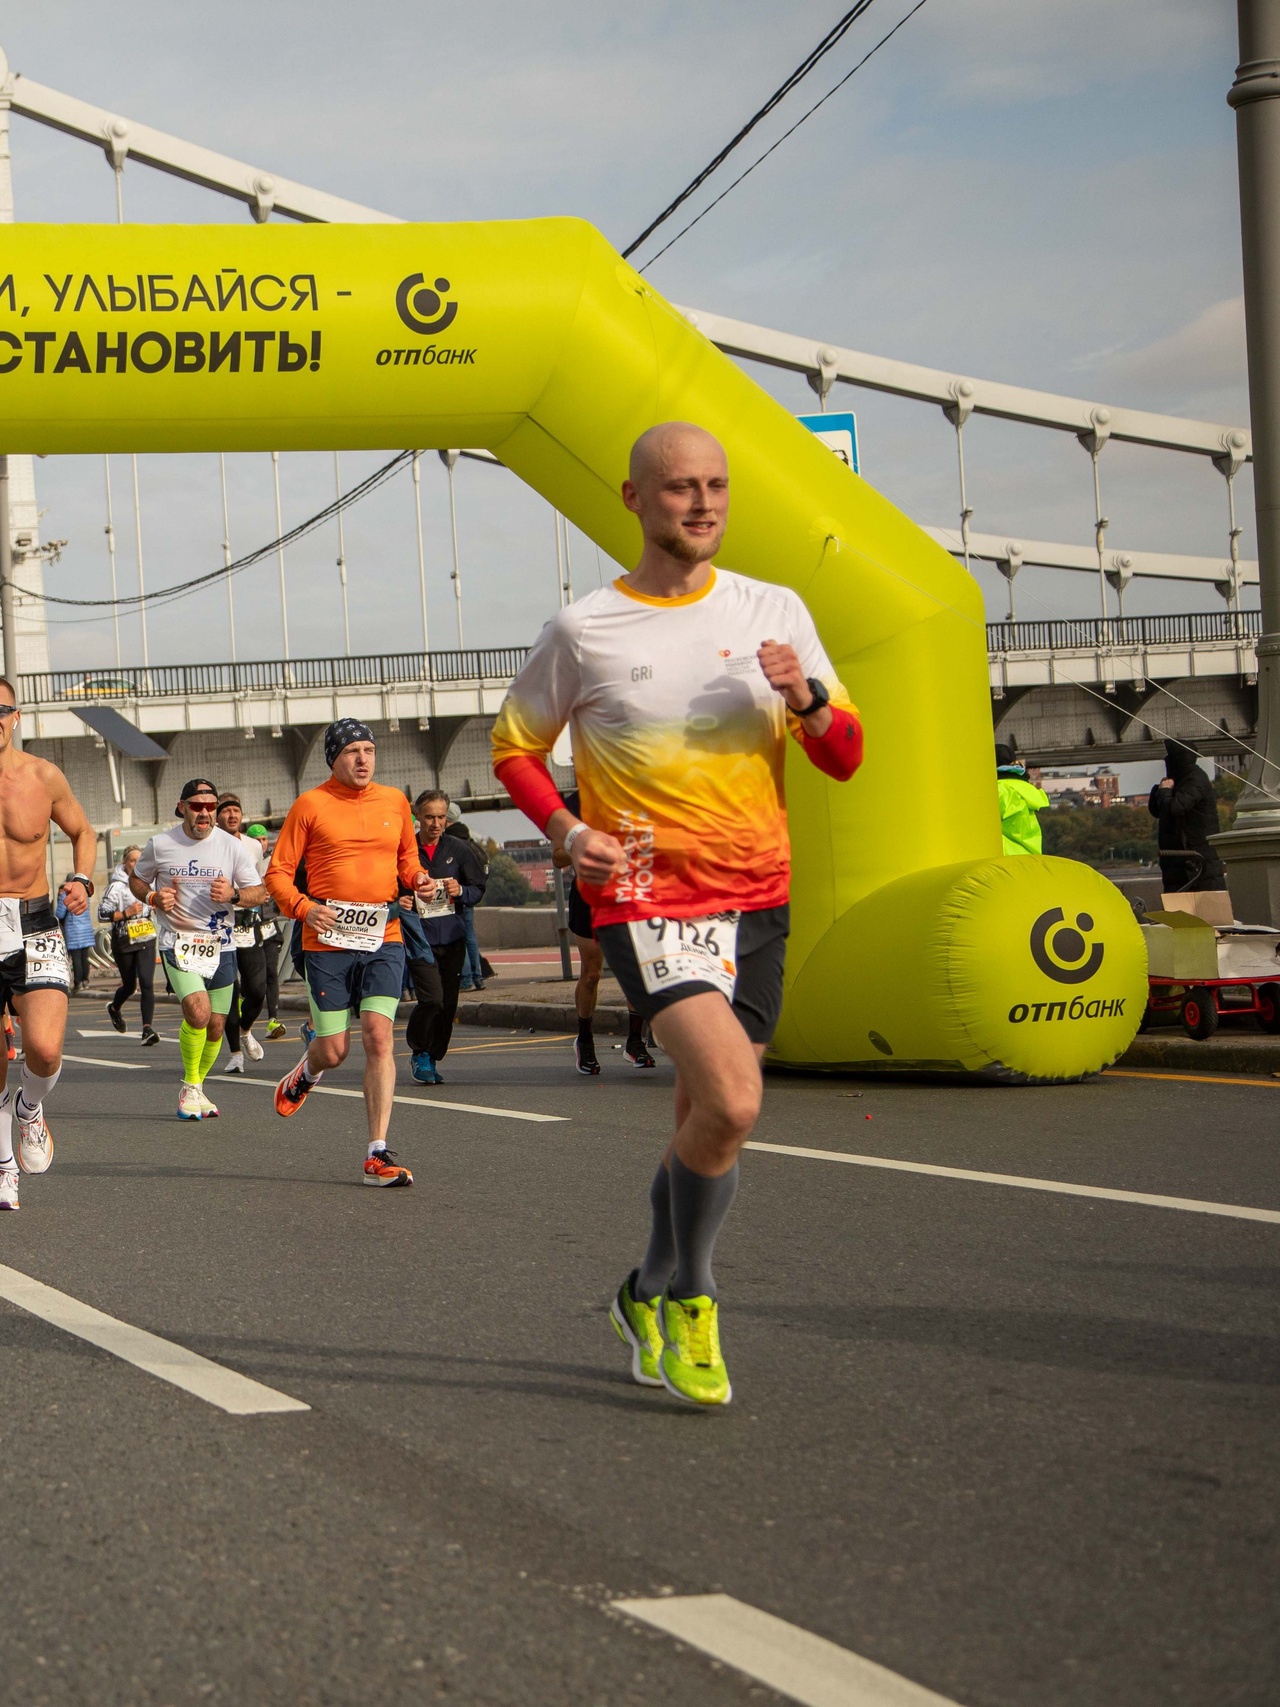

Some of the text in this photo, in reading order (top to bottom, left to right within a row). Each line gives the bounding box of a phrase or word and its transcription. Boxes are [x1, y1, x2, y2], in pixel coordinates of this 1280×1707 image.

[43, 268, 319, 312] УЛЫБАЙСЯ
[335, 907, 378, 927] 2806
[647, 916, 720, 956] 9726
[182, 943, 215, 958] 9198
[33, 962, 42, 971] D
